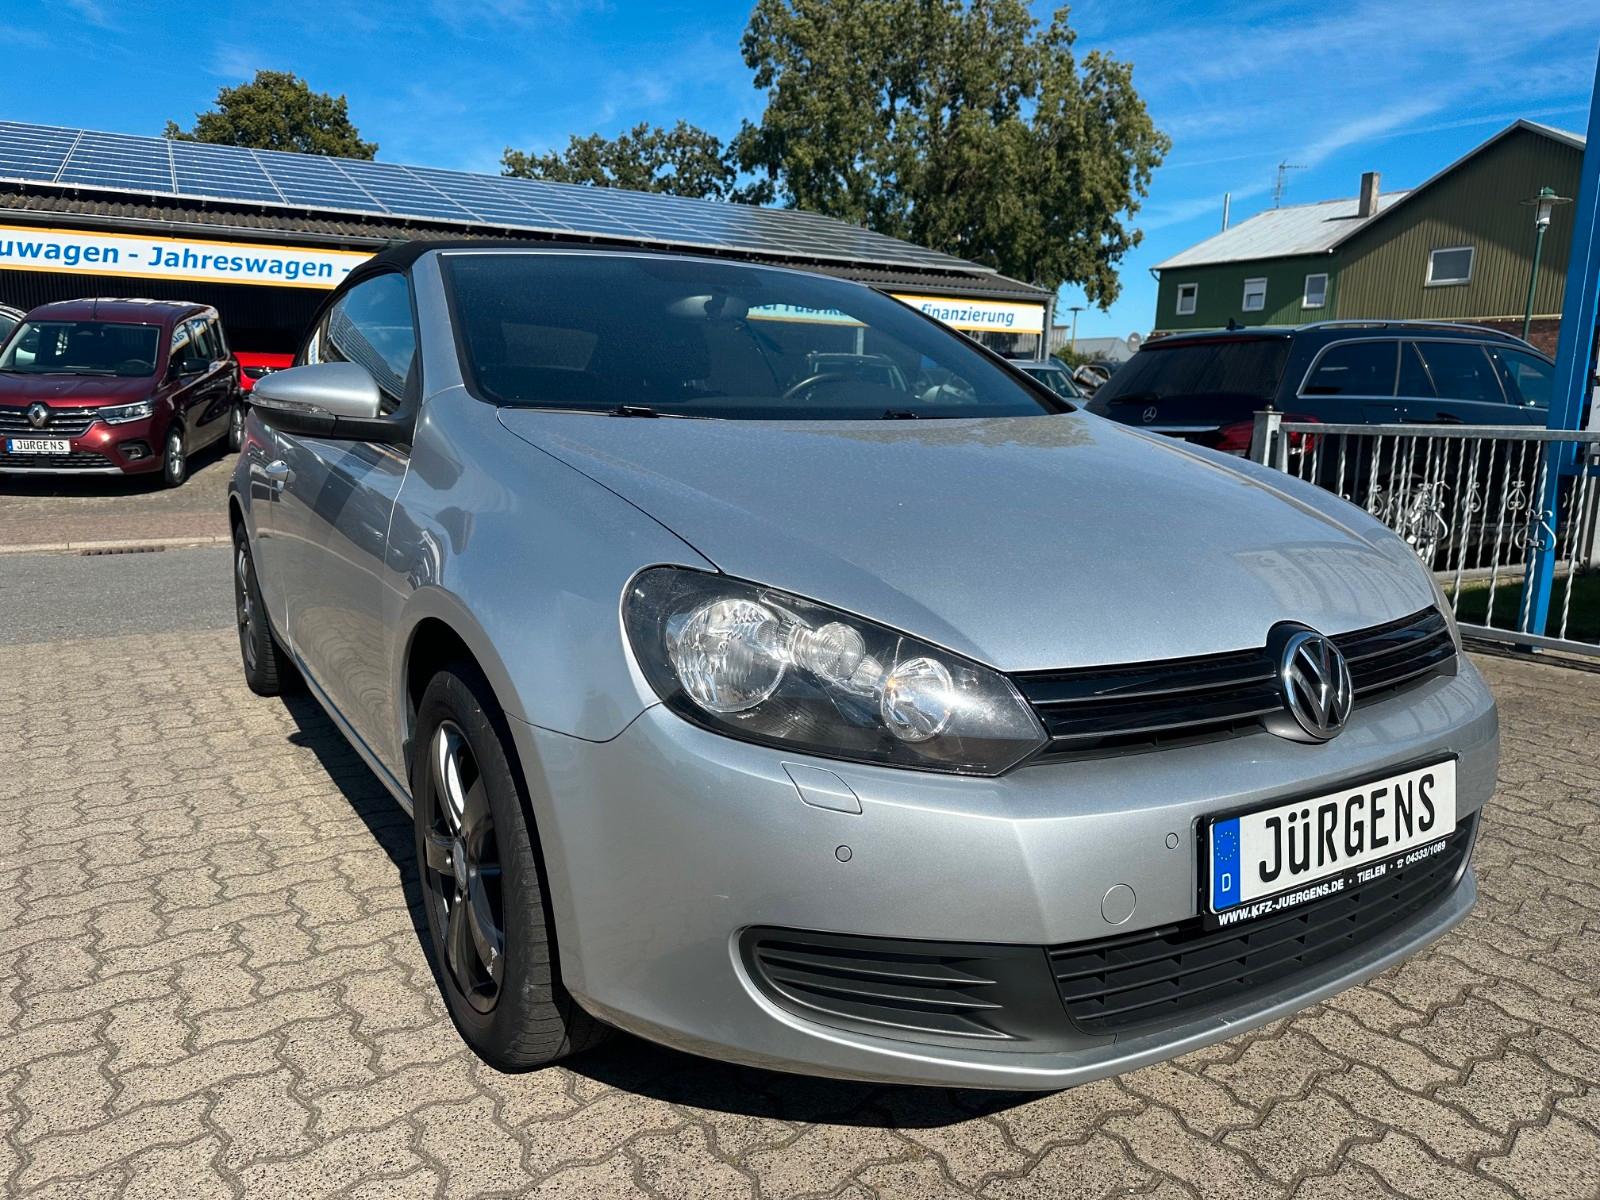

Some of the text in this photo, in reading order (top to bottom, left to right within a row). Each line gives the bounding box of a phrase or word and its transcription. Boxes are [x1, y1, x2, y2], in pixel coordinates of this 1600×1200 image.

[148, 246, 333, 280] Jahreswagen
[1221, 872, 1232, 892] D
[1357, 863, 1387, 884] TIELEN
